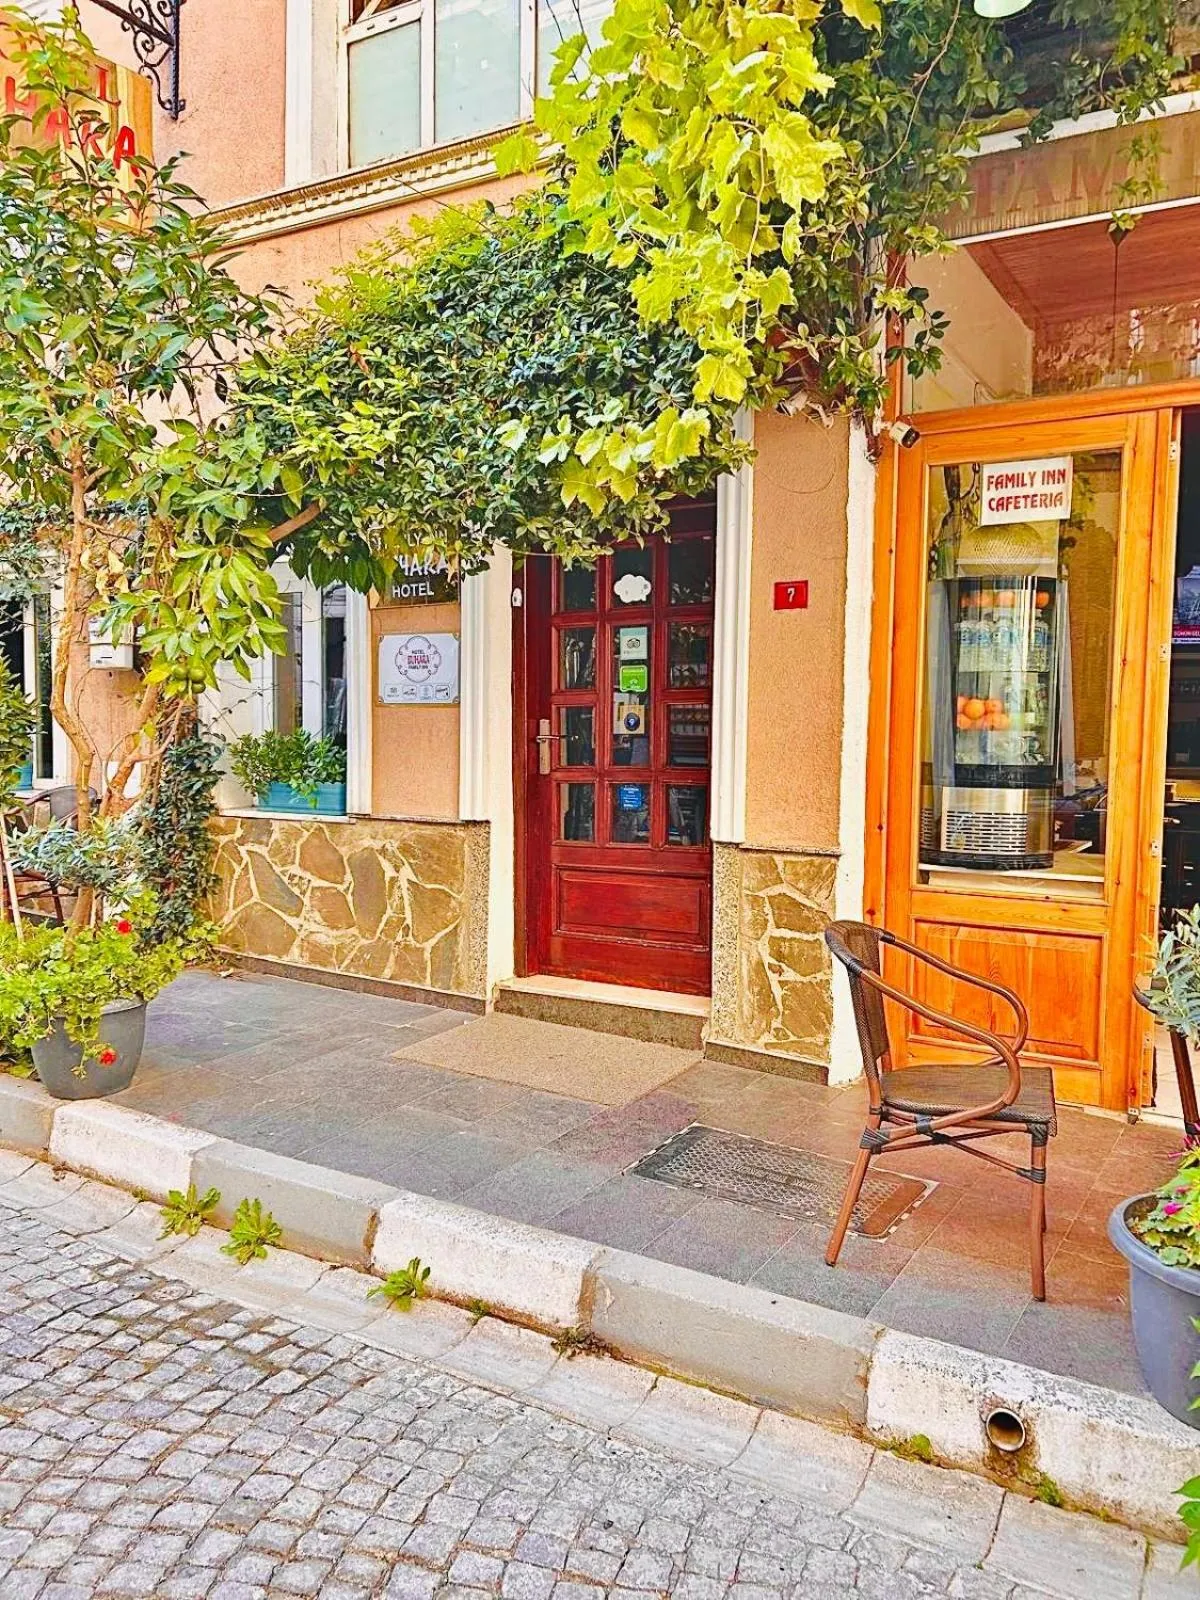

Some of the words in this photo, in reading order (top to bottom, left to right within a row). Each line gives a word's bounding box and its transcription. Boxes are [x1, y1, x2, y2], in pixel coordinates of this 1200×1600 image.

[987, 471, 1036, 491] FAMILY
[1041, 468, 1066, 485] INN
[988, 492, 1063, 512] CAFETERIA
[392, 581, 435, 598] HOTEL
[787, 587, 795, 603] 7
